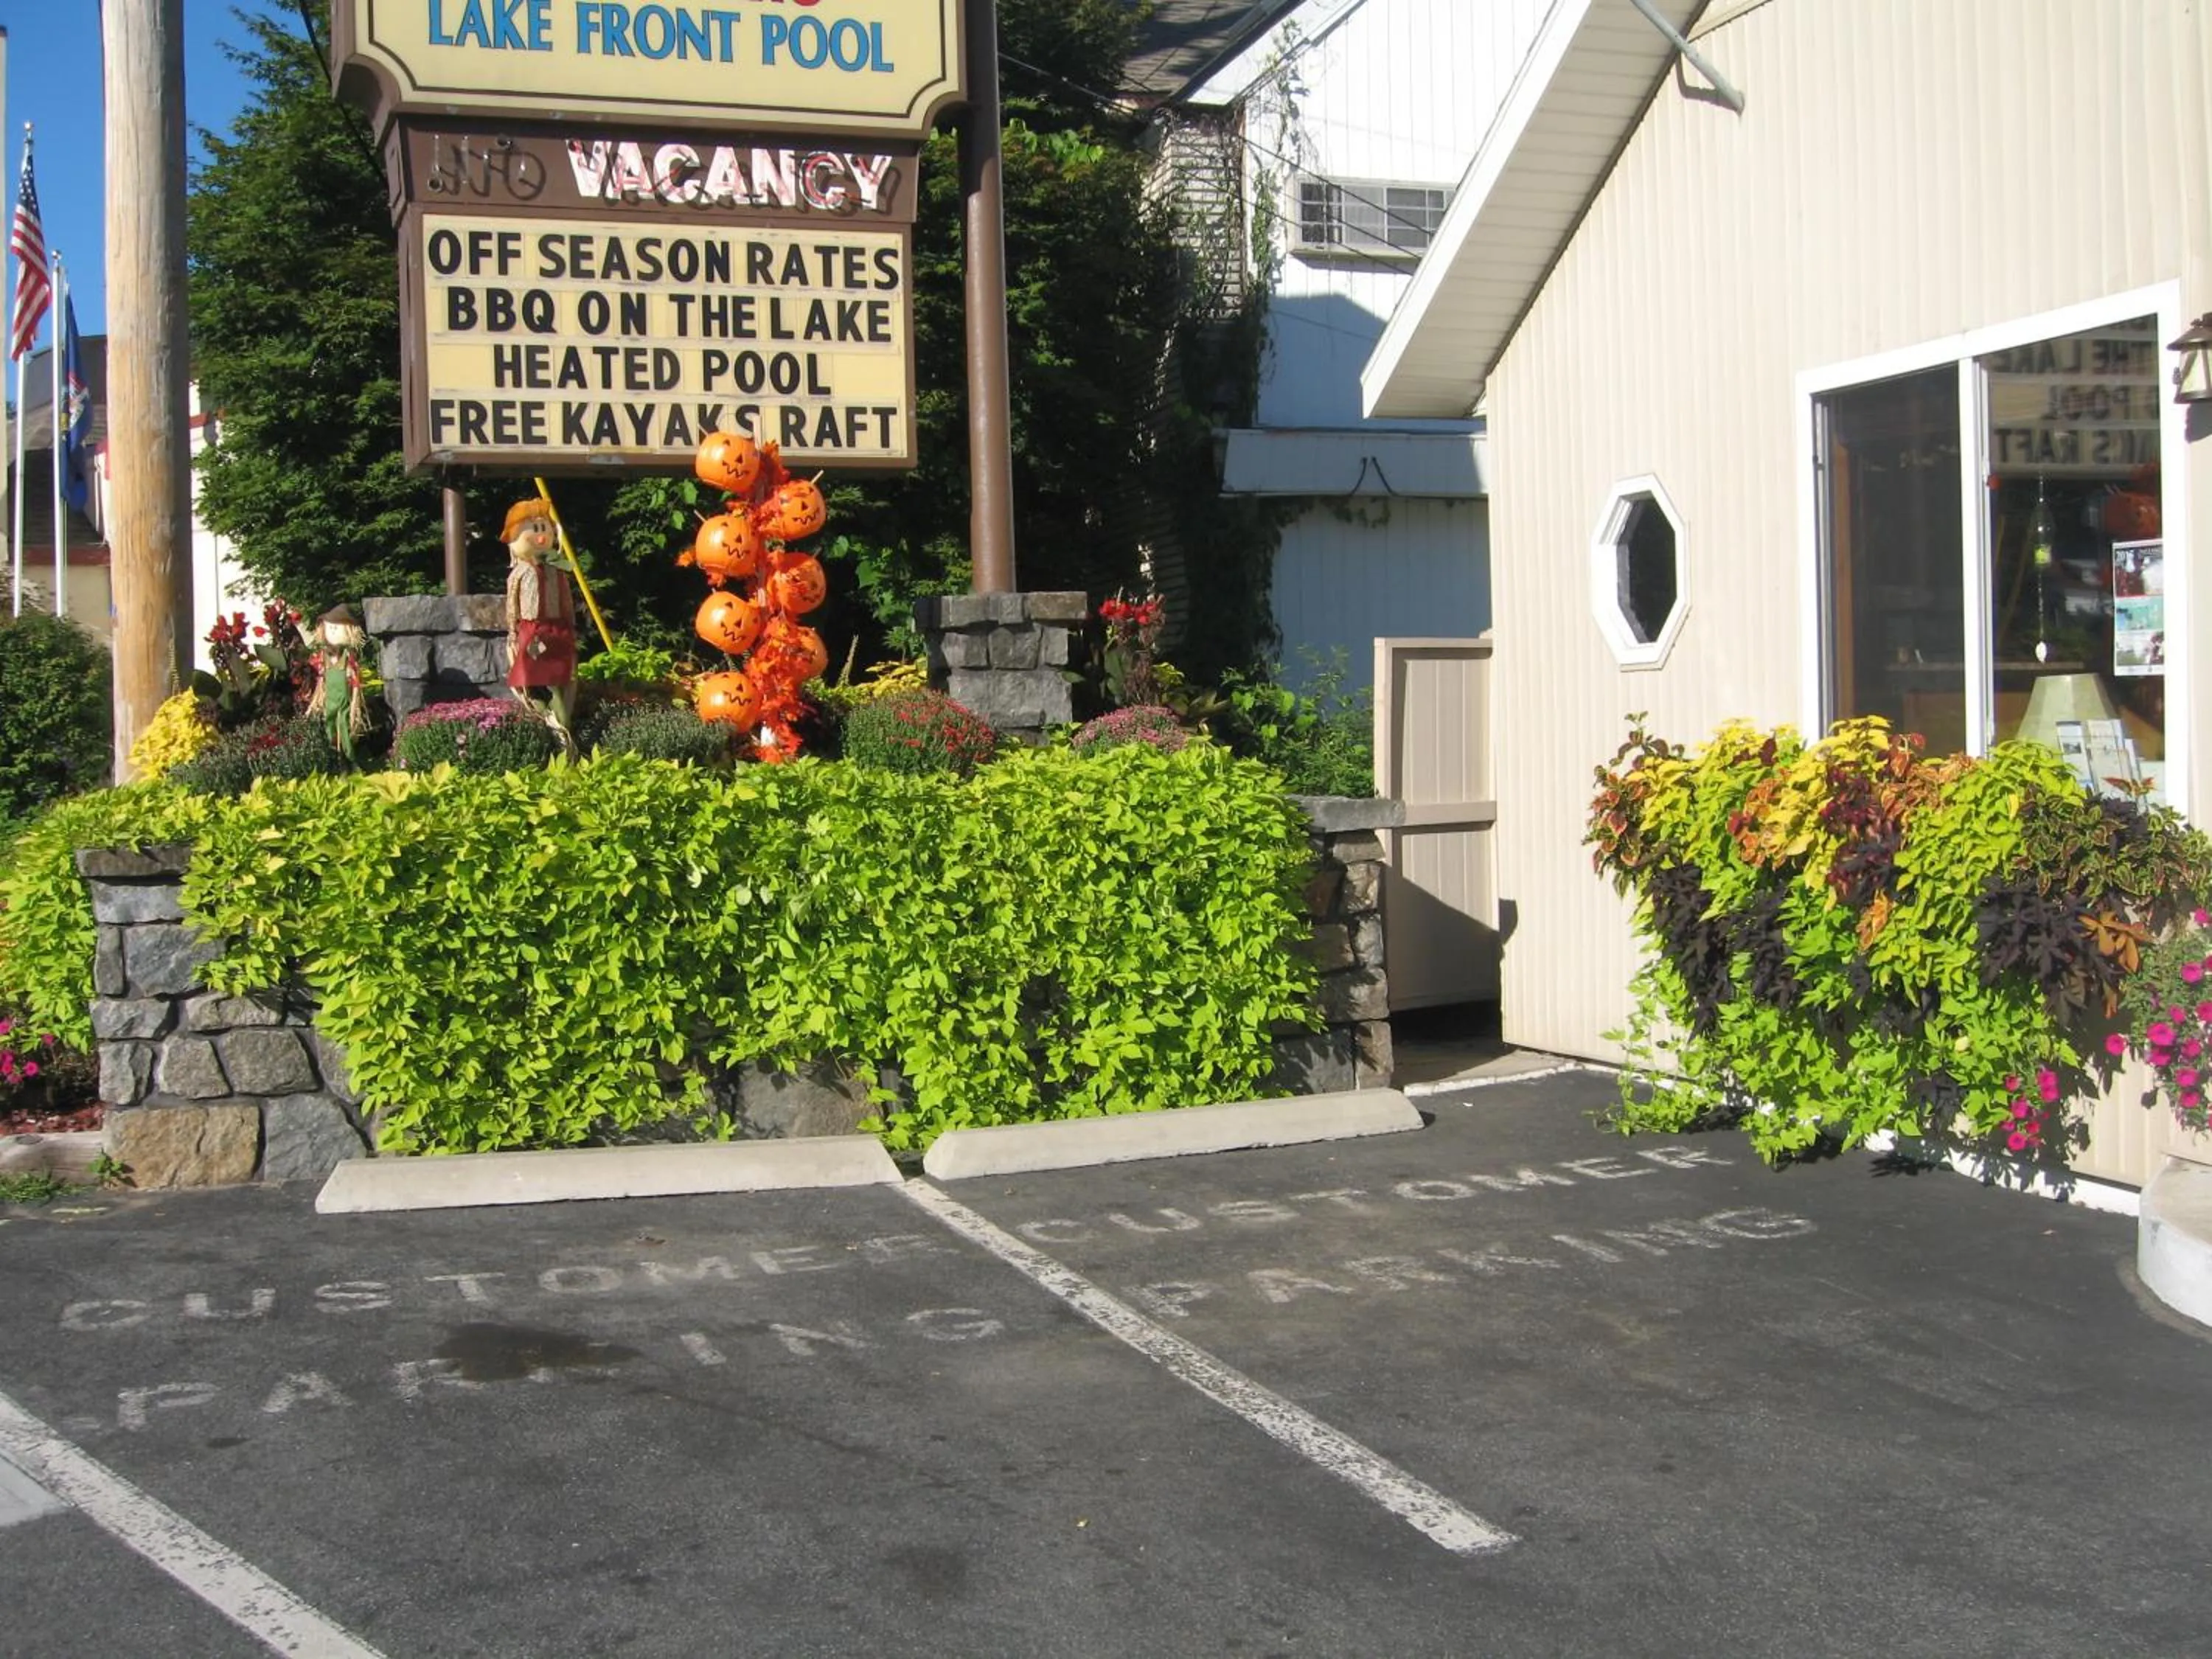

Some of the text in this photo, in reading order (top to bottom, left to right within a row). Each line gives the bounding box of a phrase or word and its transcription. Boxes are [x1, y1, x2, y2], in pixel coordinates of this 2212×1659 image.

[428, 0, 894, 72] LAKE FRONT POOL
[565, 138, 892, 210] VACANCY
[428, 229, 900, 291] OFF SEASON RATES
[448, 287, 892, 344] BBQ ON THE LAKE
[494, 344, 832, 396] HEATED POOL
[431, 400, 898, 448] FREE KAYAKS RAFT
[1018, 1144, 1735, 1245] CUSTOMER
[1124, 1205, 1818, 1318] PARKING
[116, 1306, 1004, 1433] PARING
